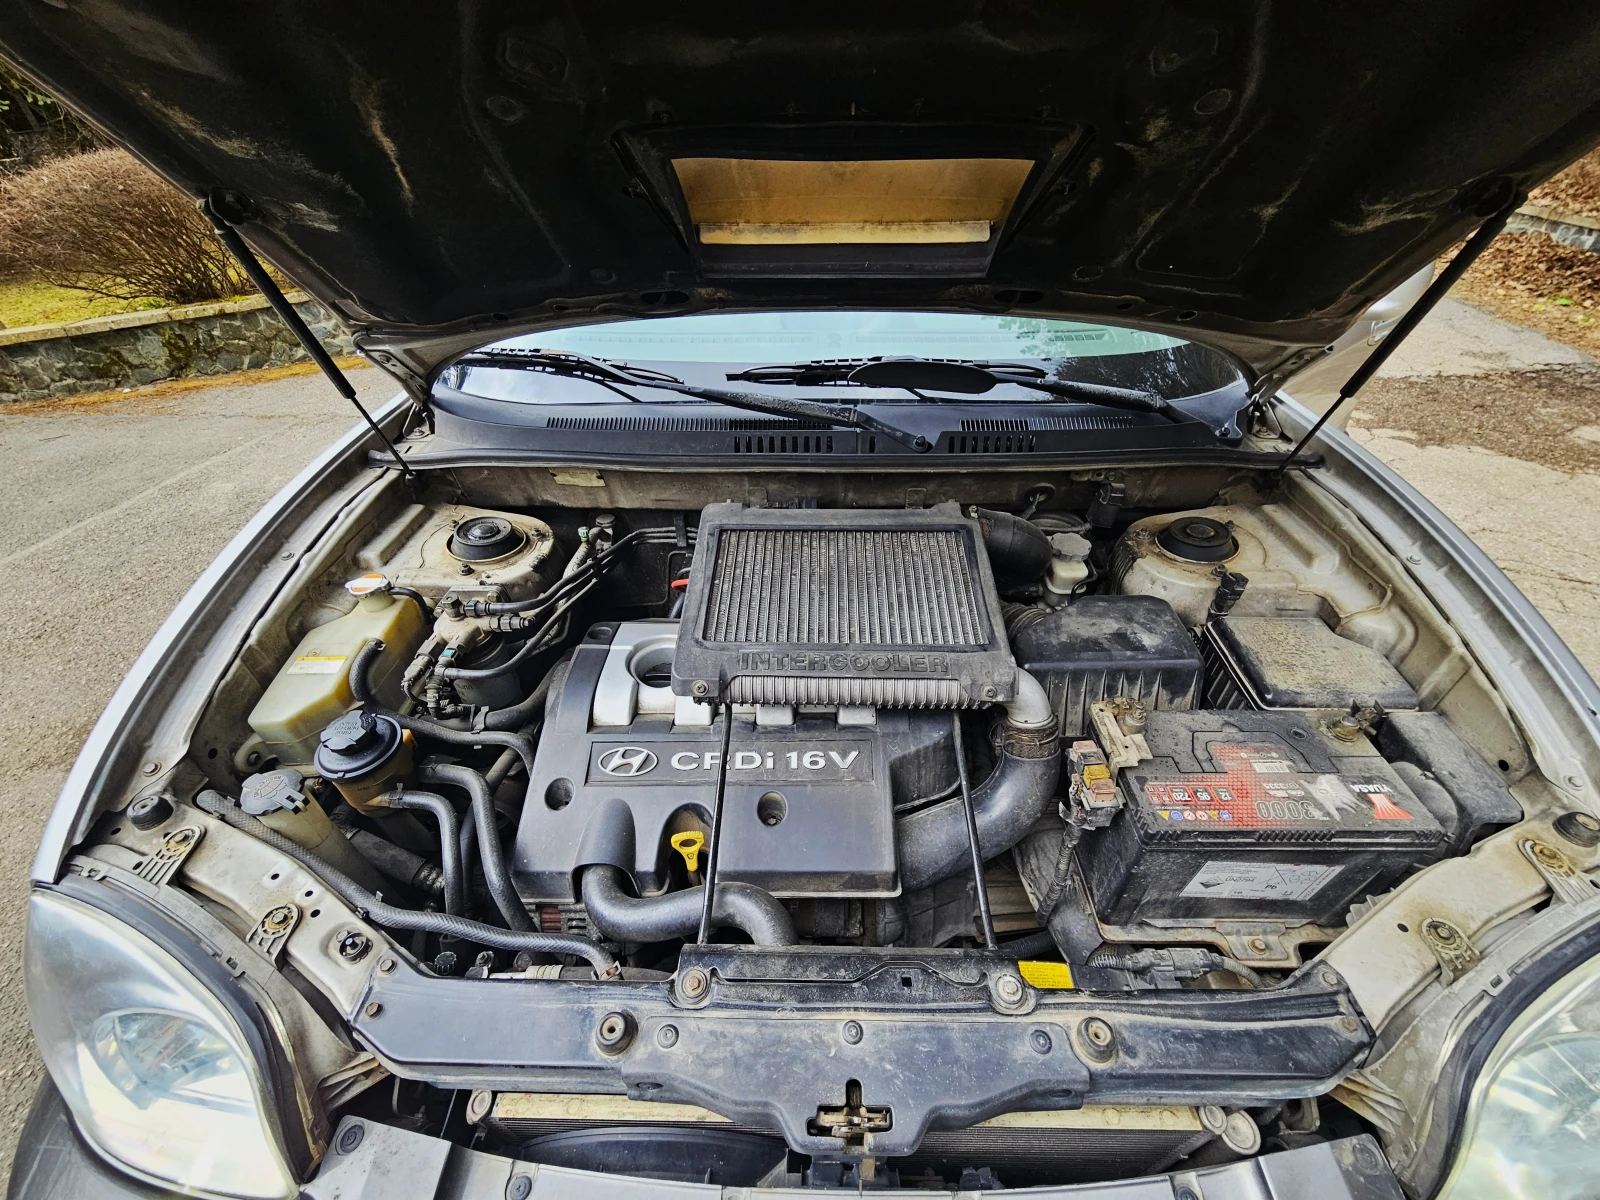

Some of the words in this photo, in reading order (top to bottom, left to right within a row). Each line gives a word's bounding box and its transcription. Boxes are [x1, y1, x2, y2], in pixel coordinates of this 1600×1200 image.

[740, 652, 949, 673] INTERCOOLER
[670, 751, 775, 771] CRDi
[786, 750, 861, 771] 16V
[1349, 784, 1393, 793] YUASA
[1172, 792, 1191, 801] 720
[1219, 792, 1233, 801] 12
[1255, 800, 1317, 820] 3000
